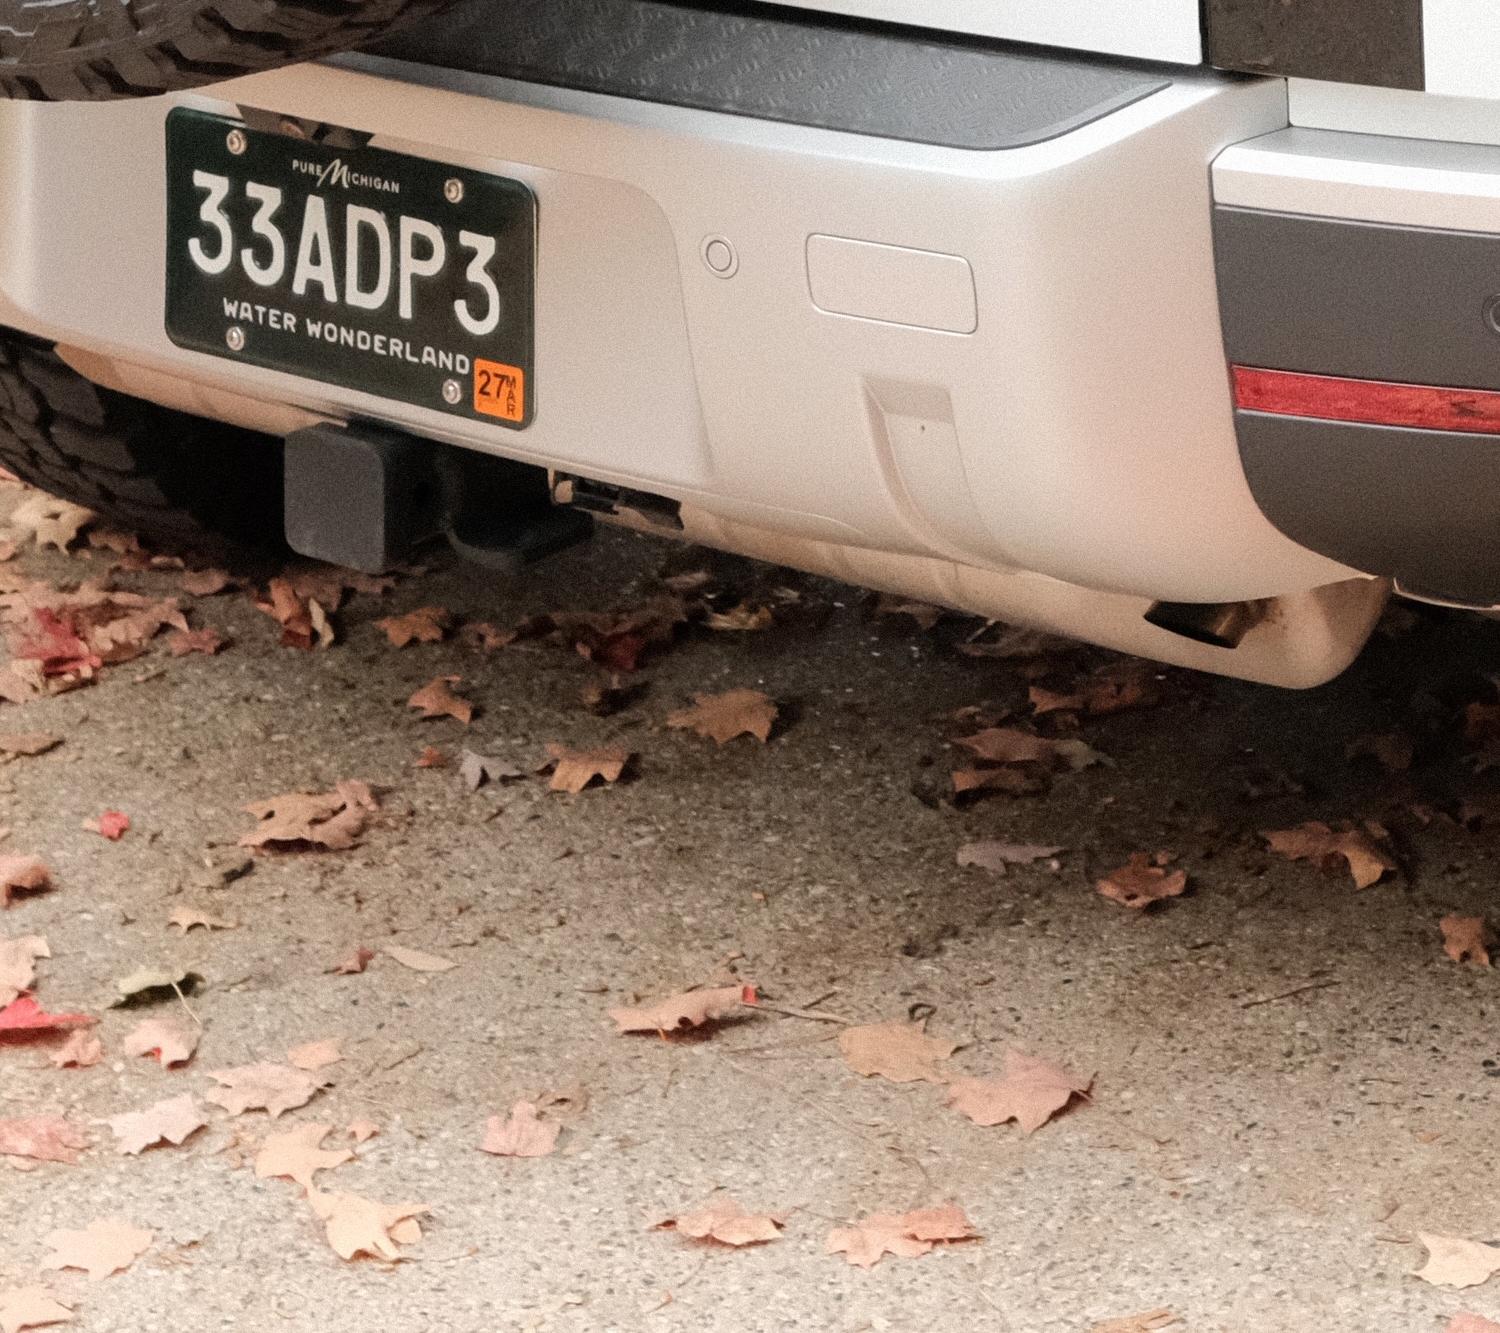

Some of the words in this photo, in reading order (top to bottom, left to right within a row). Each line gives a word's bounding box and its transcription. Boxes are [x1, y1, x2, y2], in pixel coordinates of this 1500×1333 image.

[292, 159, 323, 177] PURE
[316, 158, 400, 194] MICHIGAN
[188, 169, 501, 336] 33ADP3
[222, 297, 297, 332] WATER
[306, 317, 471, 375] WONDERLAND
[478, 369, 509, 399] 27
